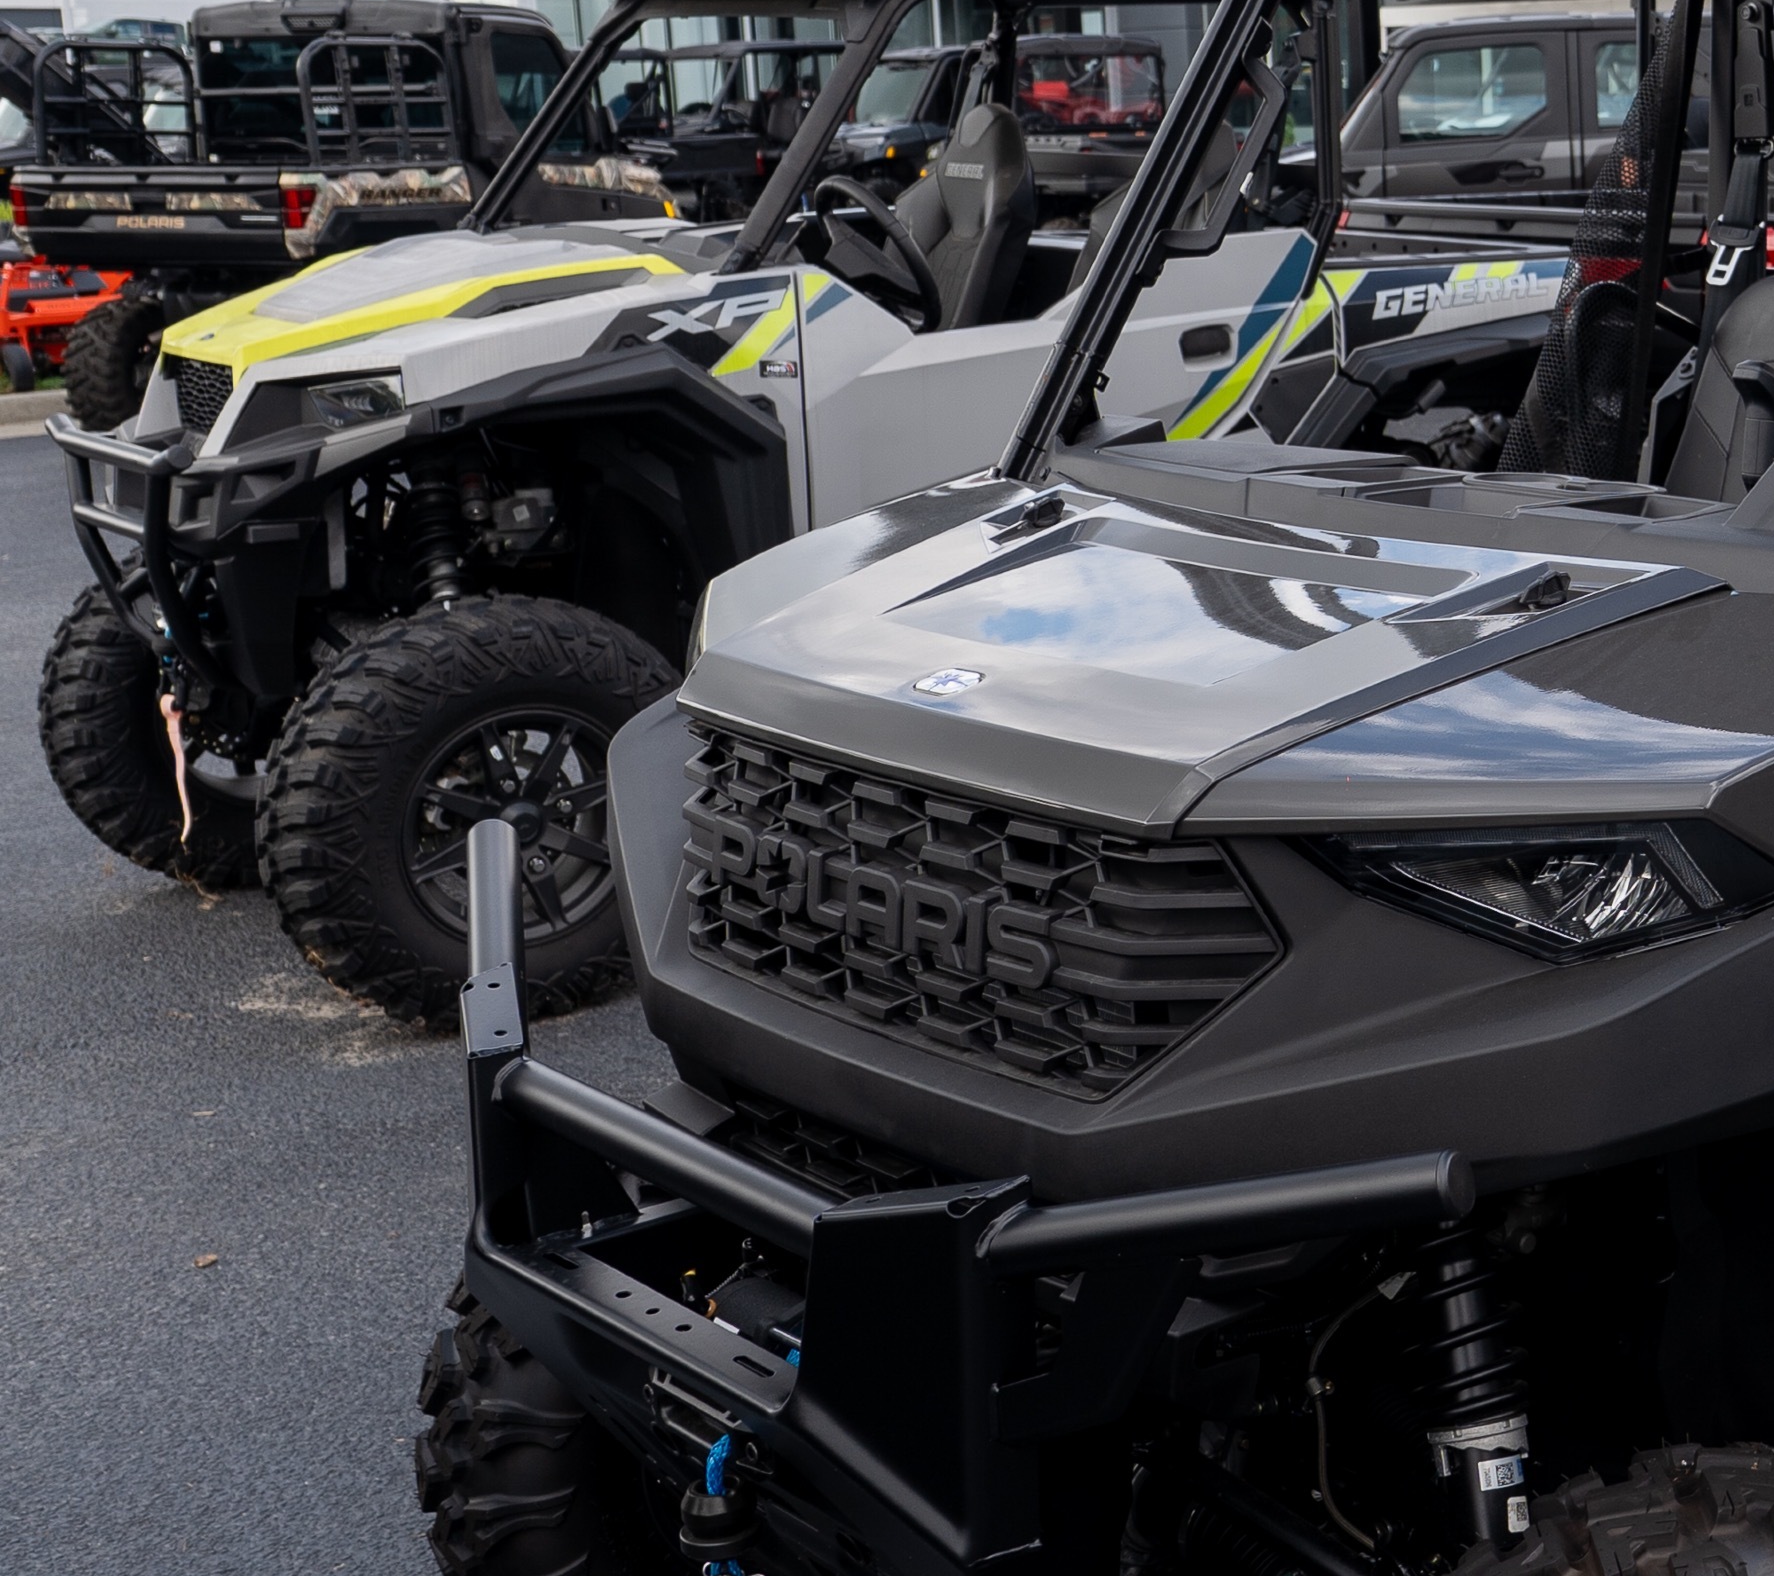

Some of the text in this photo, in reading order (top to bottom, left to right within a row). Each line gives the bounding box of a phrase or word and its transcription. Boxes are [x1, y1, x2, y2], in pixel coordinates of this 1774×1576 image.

[359, 186, 442, 201] RANGER
[116, 216, 185, 229] POLARIS
[646, 288, 788, 342] XP
[1372, 272, 1549, 320] GENERAL
[712, 811, 1058, 990] POLARIS
